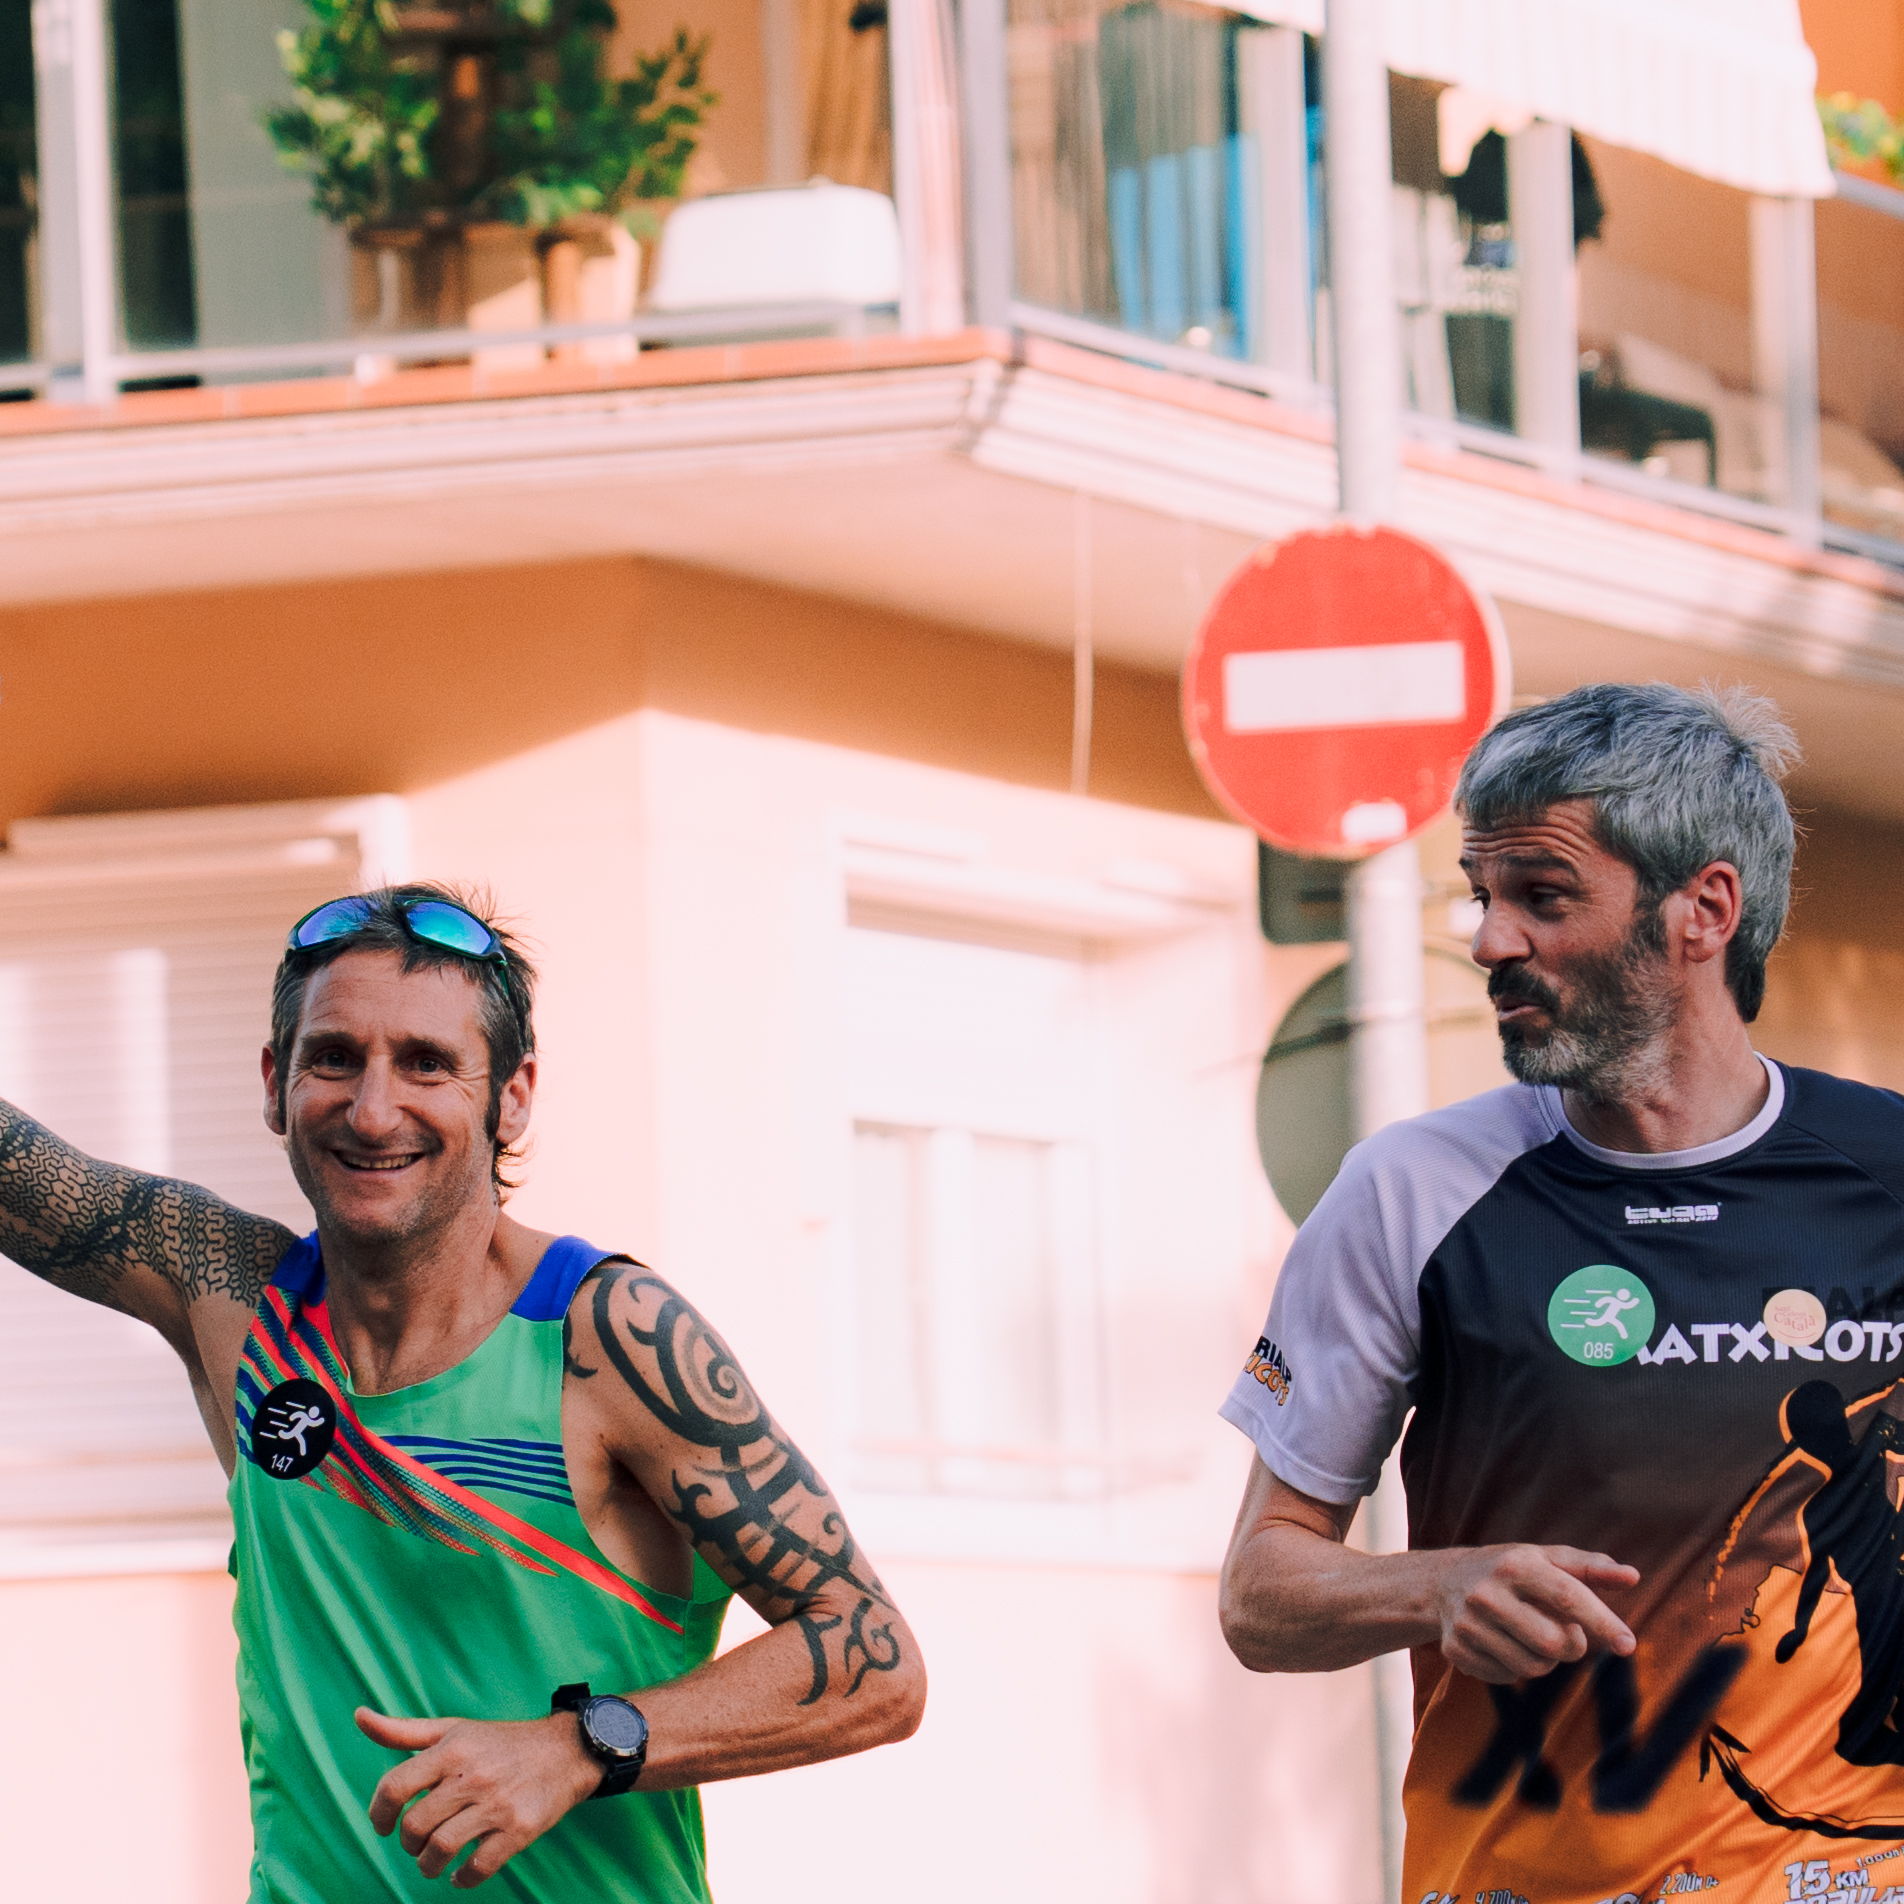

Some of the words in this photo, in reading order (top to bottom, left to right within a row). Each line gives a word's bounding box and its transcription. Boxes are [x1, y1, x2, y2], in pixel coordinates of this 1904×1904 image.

[1774, 1312, 1816, 1332] Català
[1583, 1341, 1614, 1359] 085
[1243, 1354, 1289, 1406] ICOTS
[271, 1453, 294, 1472] 147
[1450, 1643, 1750, 1813] XV
[1784, 1859, 1832, 1900] 15
[1835, 1867, 1869, 1889] KM
